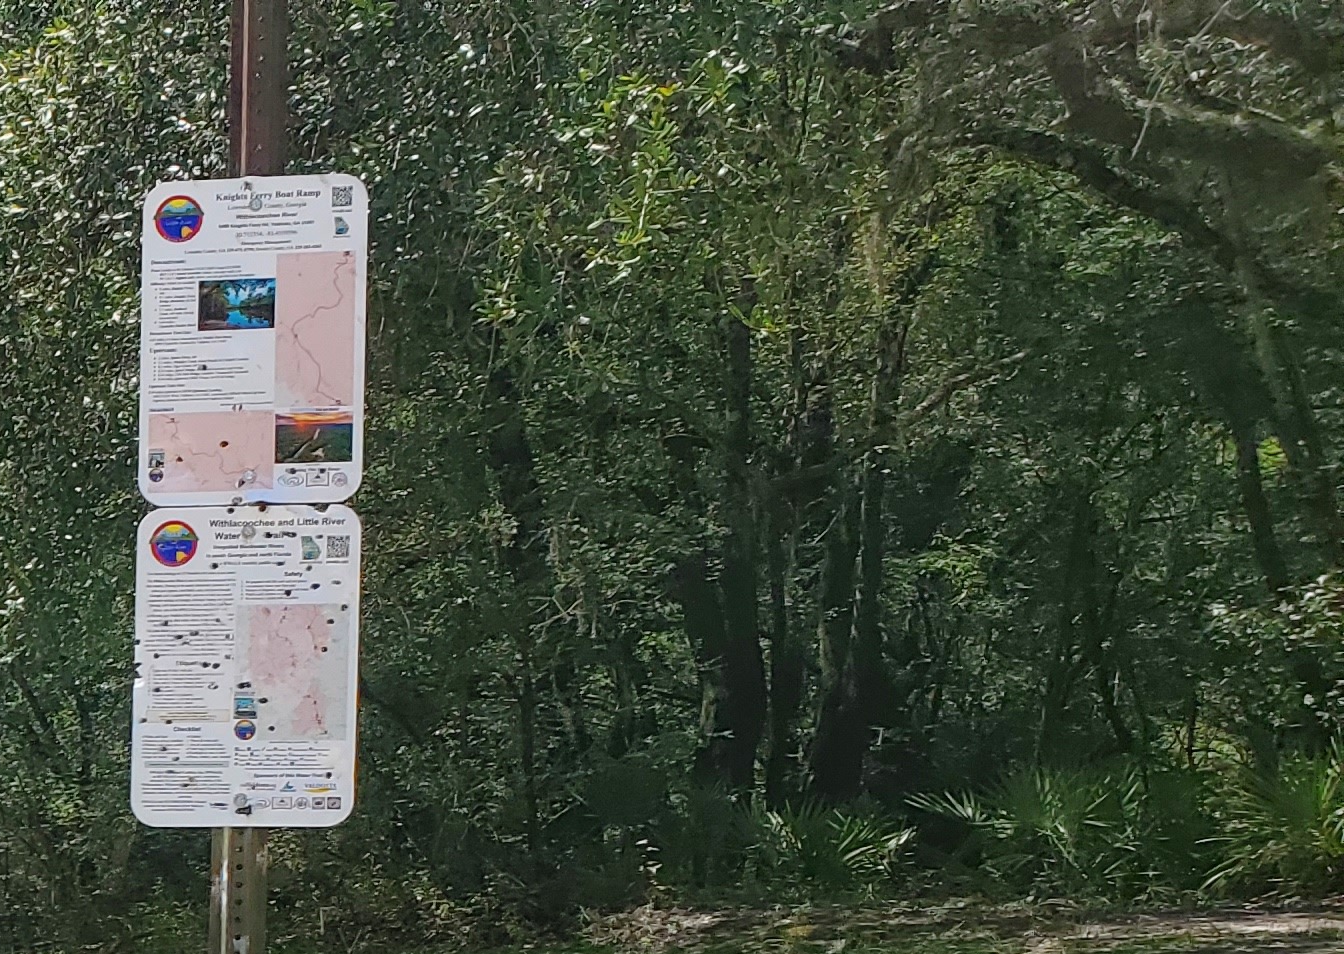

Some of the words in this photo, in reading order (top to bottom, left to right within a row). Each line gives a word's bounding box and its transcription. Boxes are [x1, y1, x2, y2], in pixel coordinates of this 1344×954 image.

[216, 193, 248, 202] Knights
[250, 191, 272, 200] Ferry
[275, 190, 294, 199] Boat
[296, 190, 321, 199] Ramp
[209, 519, 275, 527] Withlacoochee
[277, 519, 295, 527] and
[214, 532, 241, 540] Water
